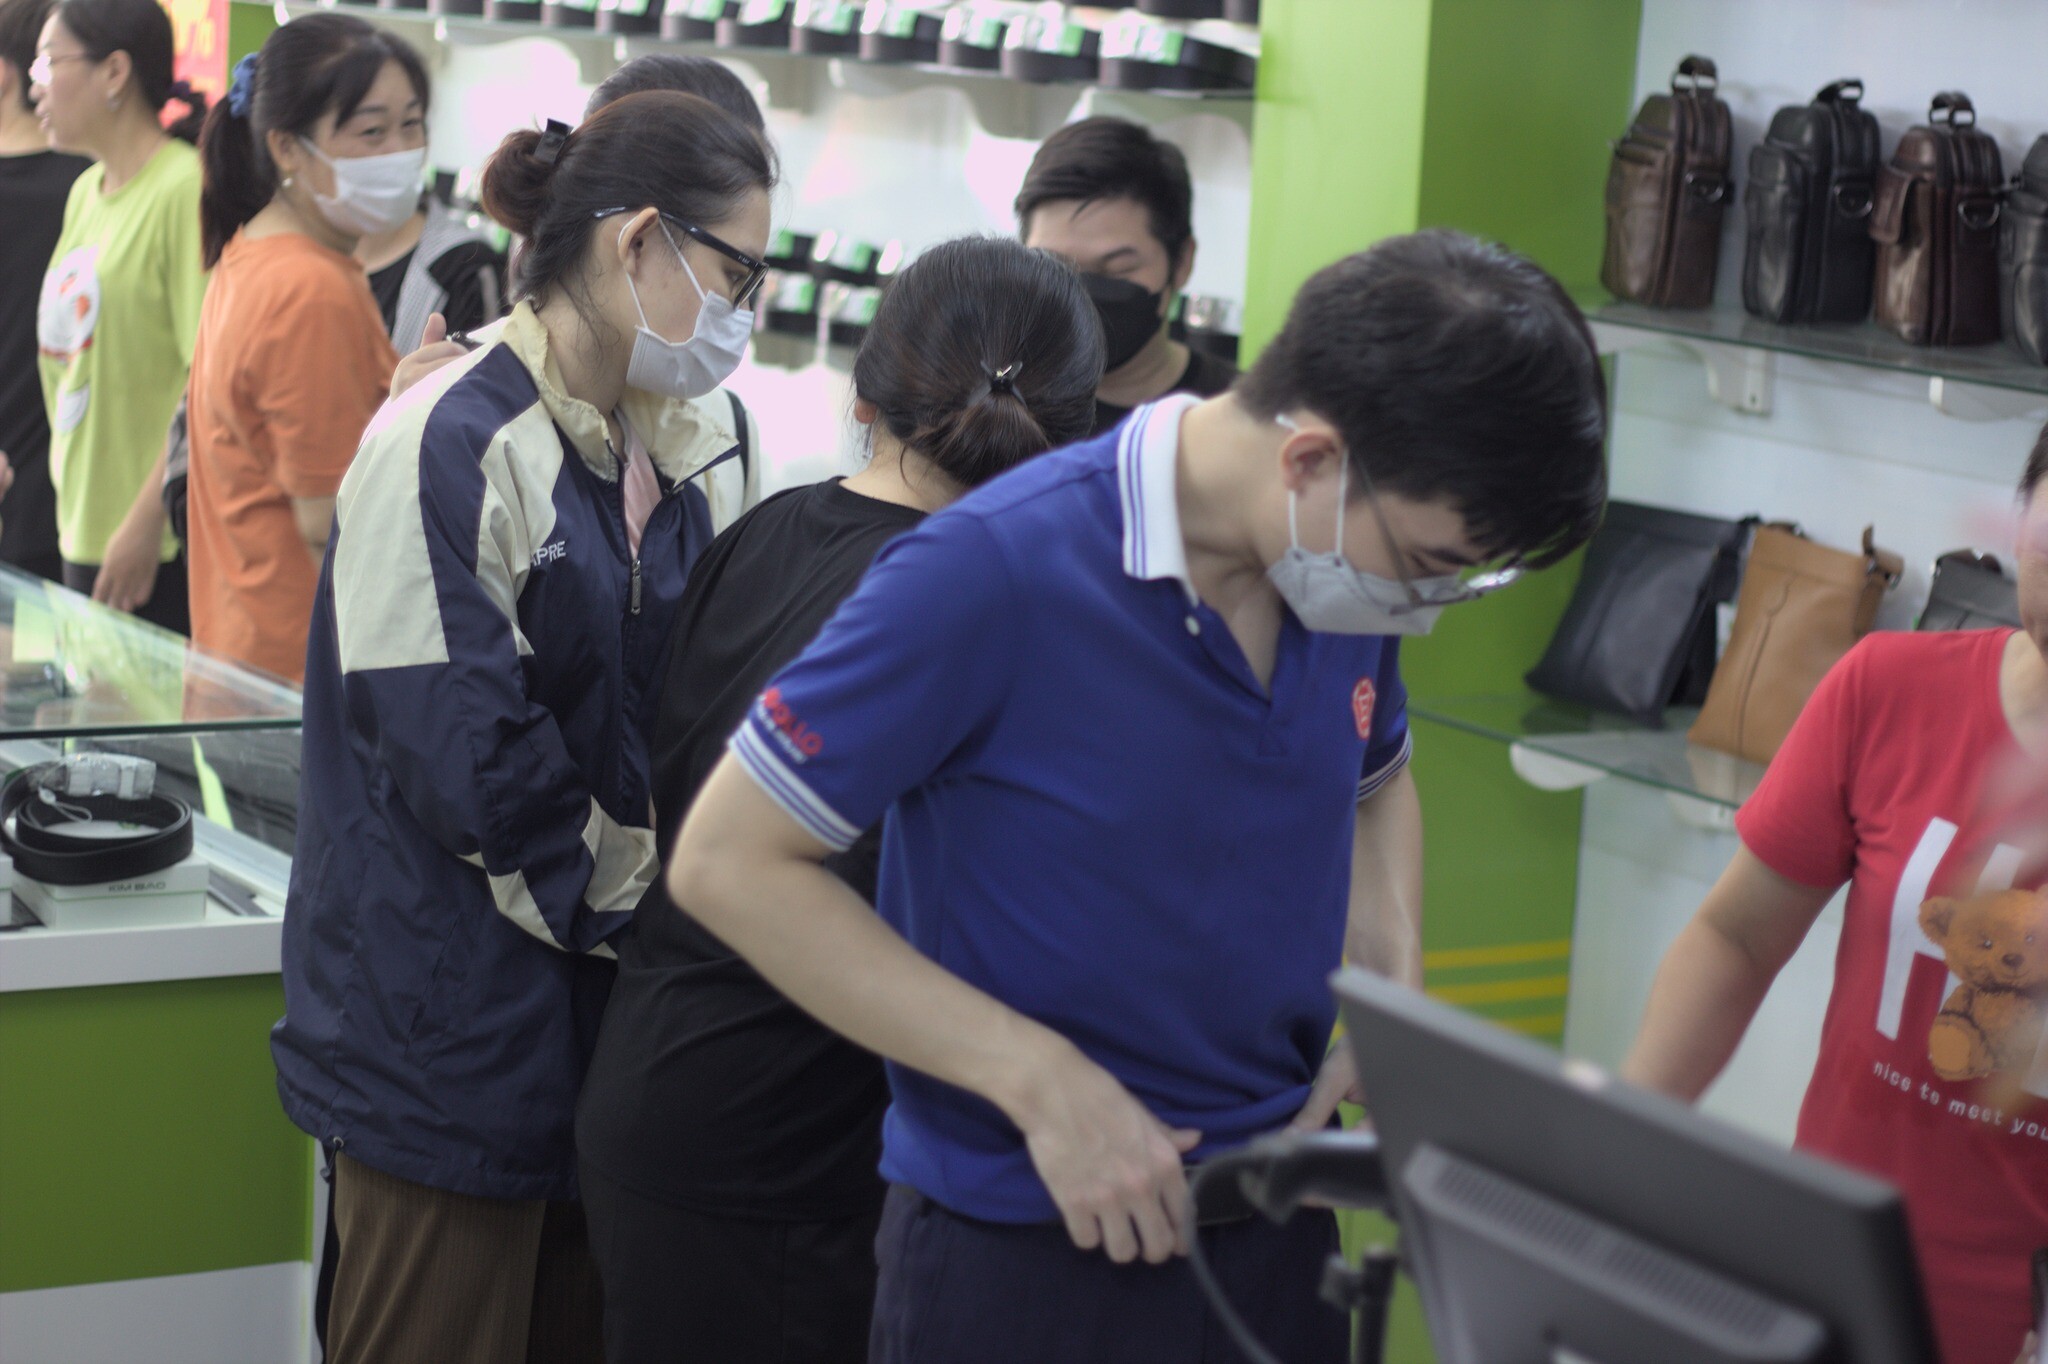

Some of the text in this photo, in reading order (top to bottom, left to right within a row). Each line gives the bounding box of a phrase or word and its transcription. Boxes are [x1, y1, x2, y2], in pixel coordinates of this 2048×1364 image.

[1873, 1061, 1912, 1092] nice
[1920, 1082, 1940, 1106] to
[1948, 1099, 2004, 1127] meet
